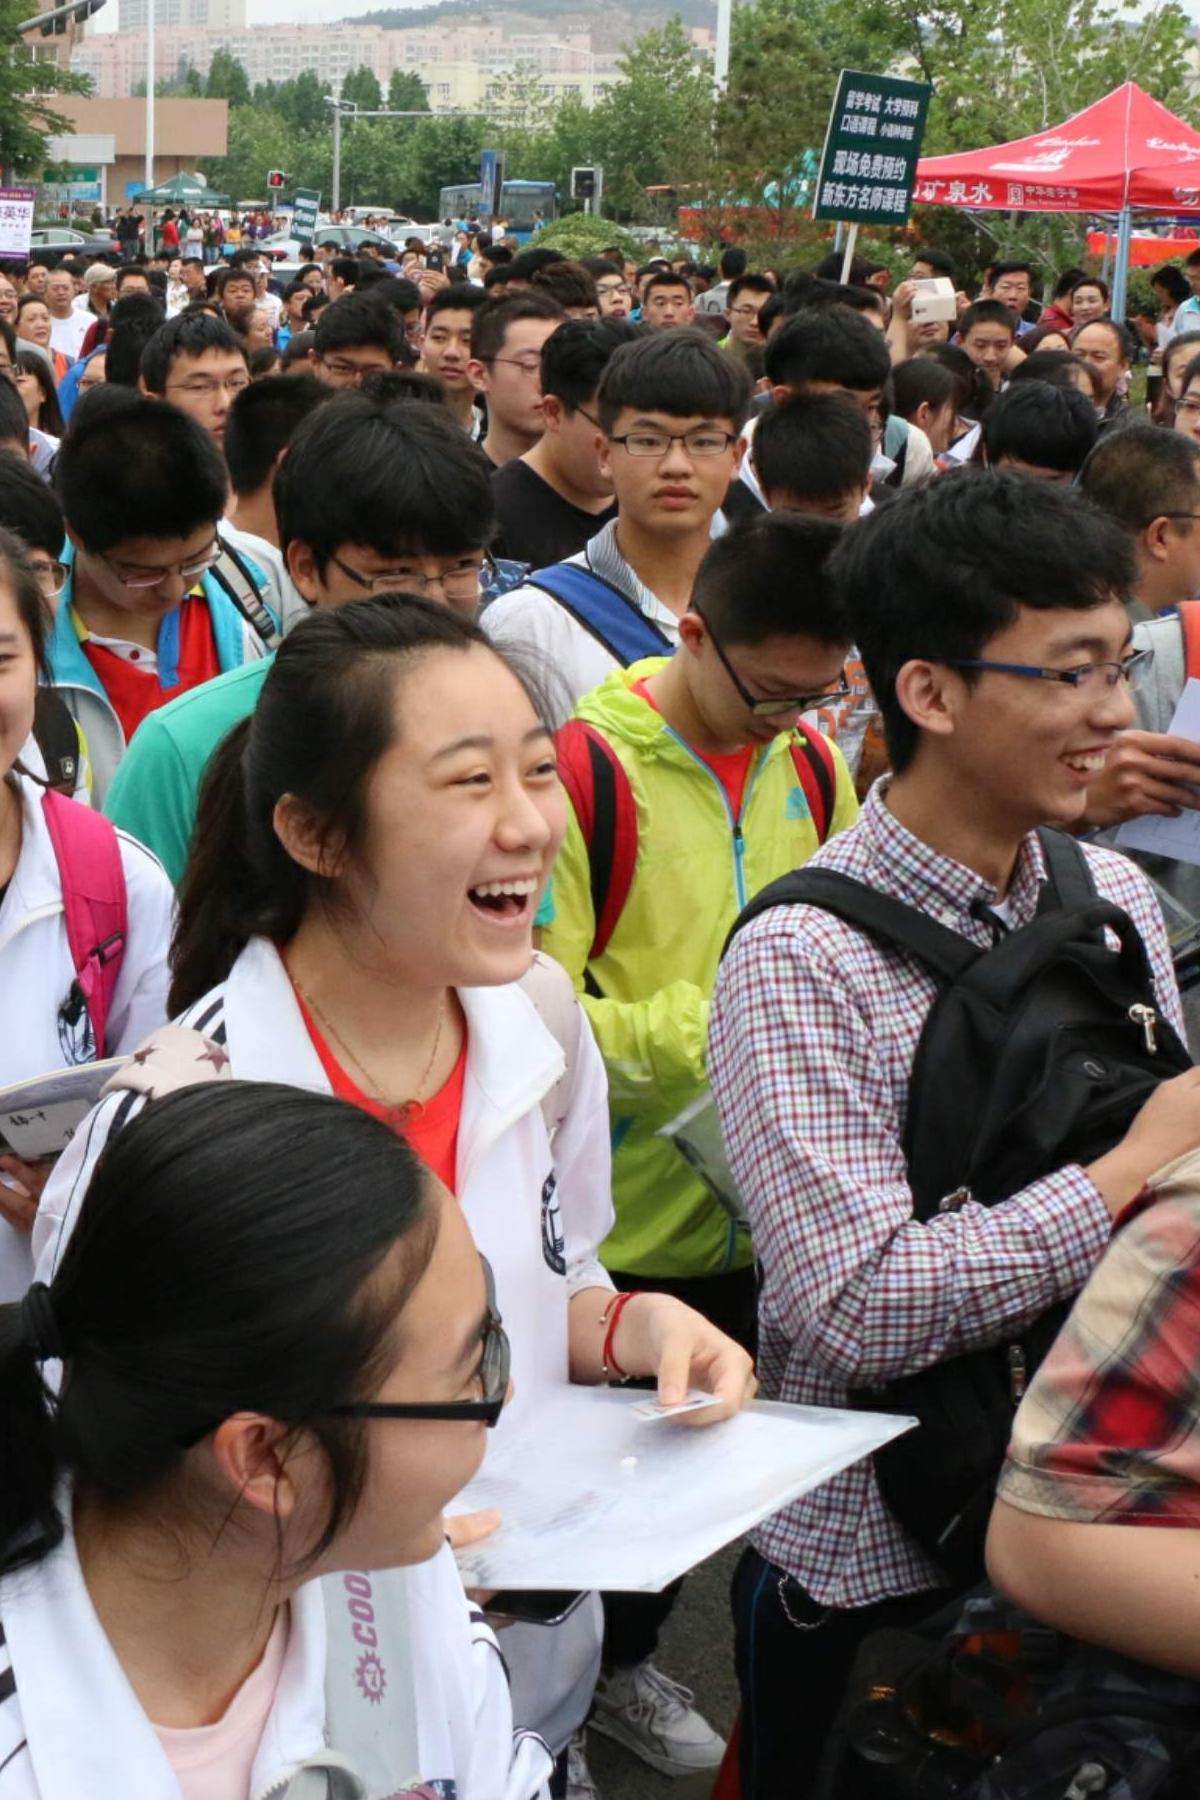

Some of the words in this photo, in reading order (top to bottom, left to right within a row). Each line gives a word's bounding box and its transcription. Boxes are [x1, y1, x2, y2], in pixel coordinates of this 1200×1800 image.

[832, 150, 908, 182] 现场免费预约
[820, 181, 909, 214] 新东方名师课程
[343, 1570, 378, 1648] COO
